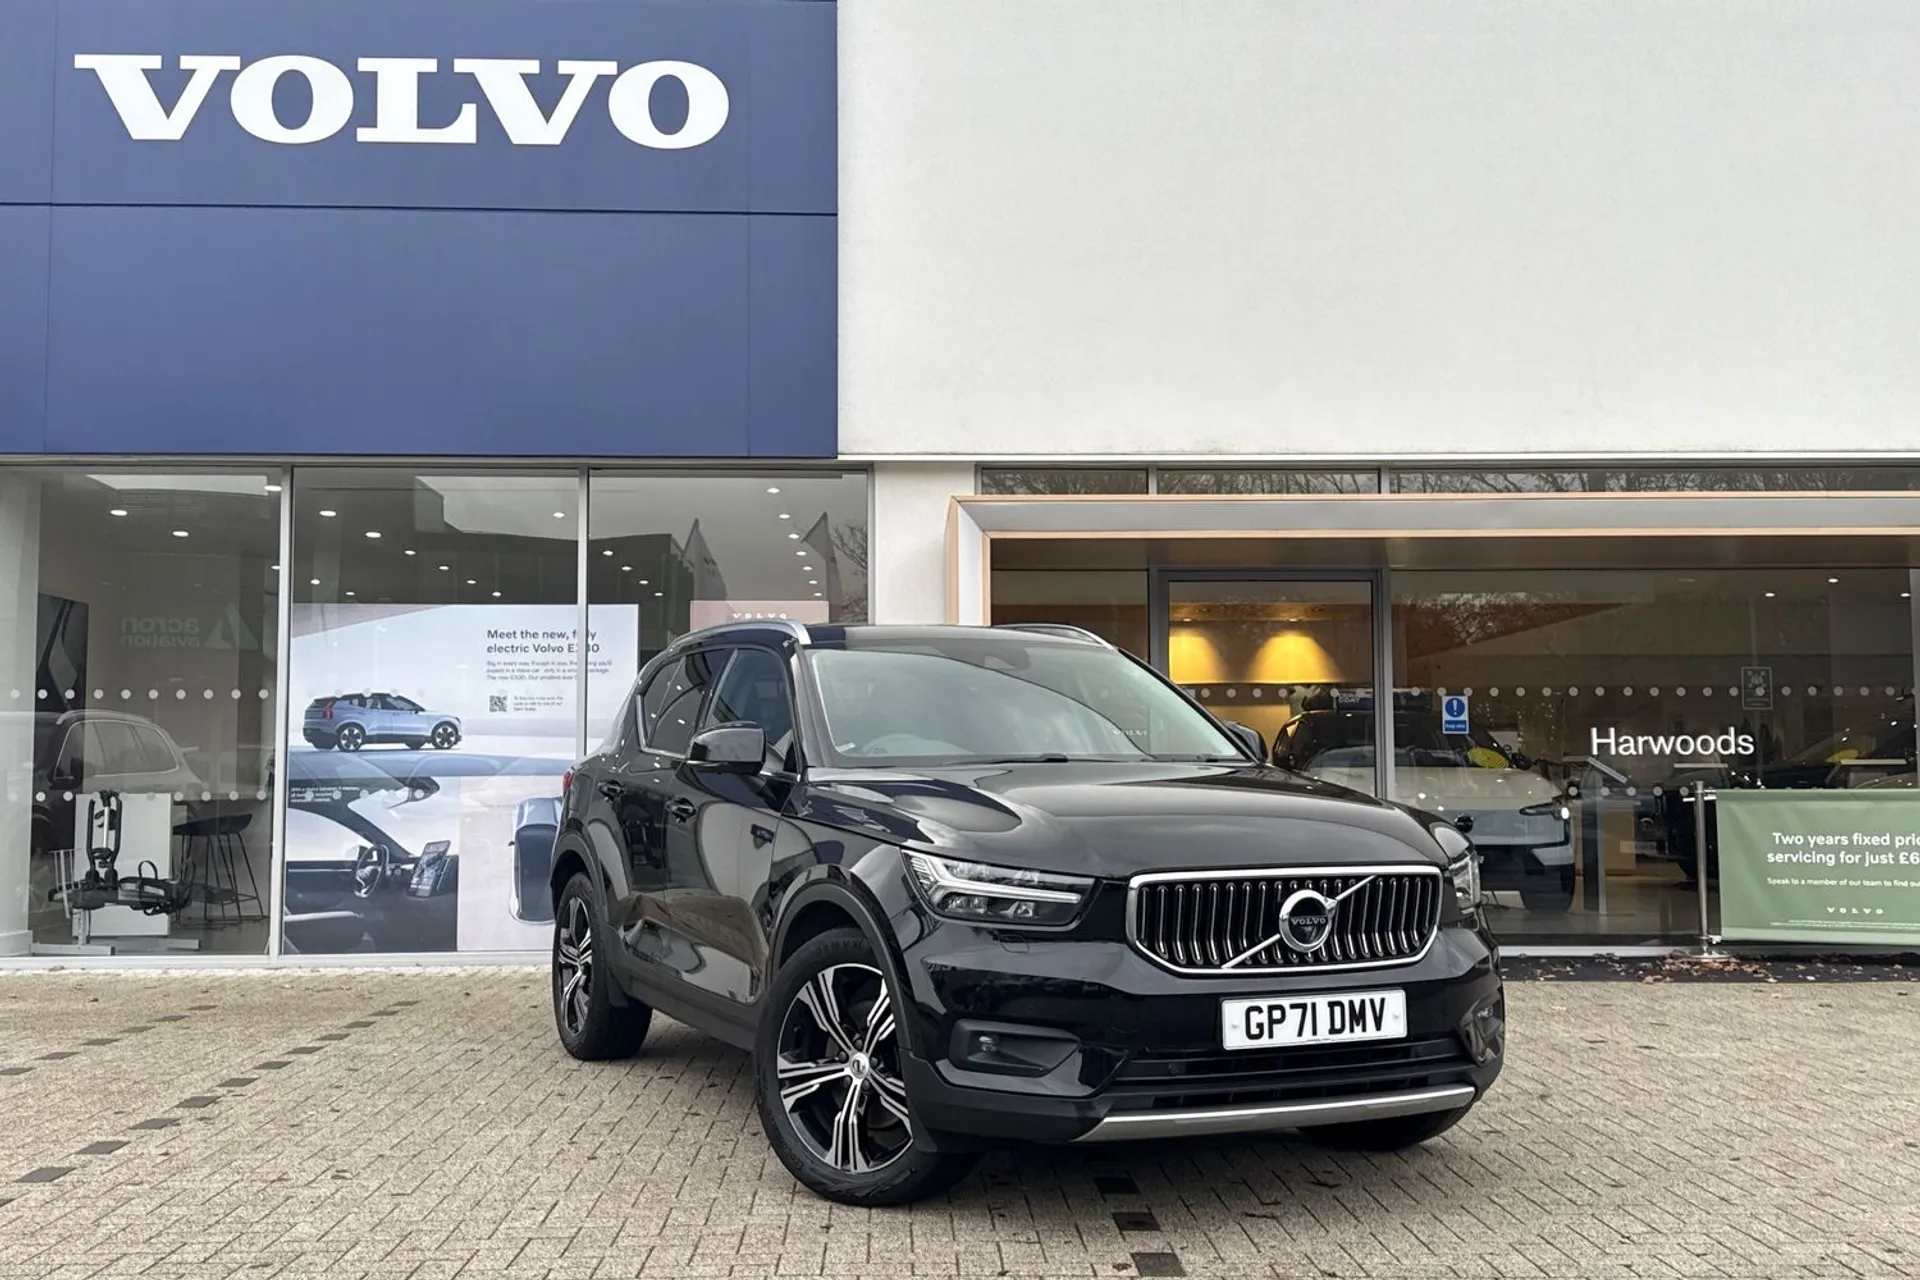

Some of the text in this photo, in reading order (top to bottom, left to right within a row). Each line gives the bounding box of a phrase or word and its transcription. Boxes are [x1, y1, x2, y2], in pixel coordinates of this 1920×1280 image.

[74, 53, 730, 150] VOLVO
[487, 629, 517, 640] Meet
[520, 629, 540, 640] the
[542, 631, 570, 641] new,
[486, 643, 600, 653] electric Volvo E30
[1590, 726, 1755, 755] Harwoods
[1772, 832, 1804, 845] Two
[1807, 834, 1849, 848] years
[1852, 832, 1891, 846] fixed
[1767, 850, 1836, 866] servicing
[1839, 851, 1861, 864] for
[1864, 851, 1895, 867] just
[1766, 877, 1790, 885] Speak
[1807, 878, 1838, 886] member
[1839, 878, 1848, 886] of
[1893, 879, 1909, 887] find
[1291, 917, 1327, 925] VOLVO
[1245, 997, 1386, 1040] GP71 DMV
